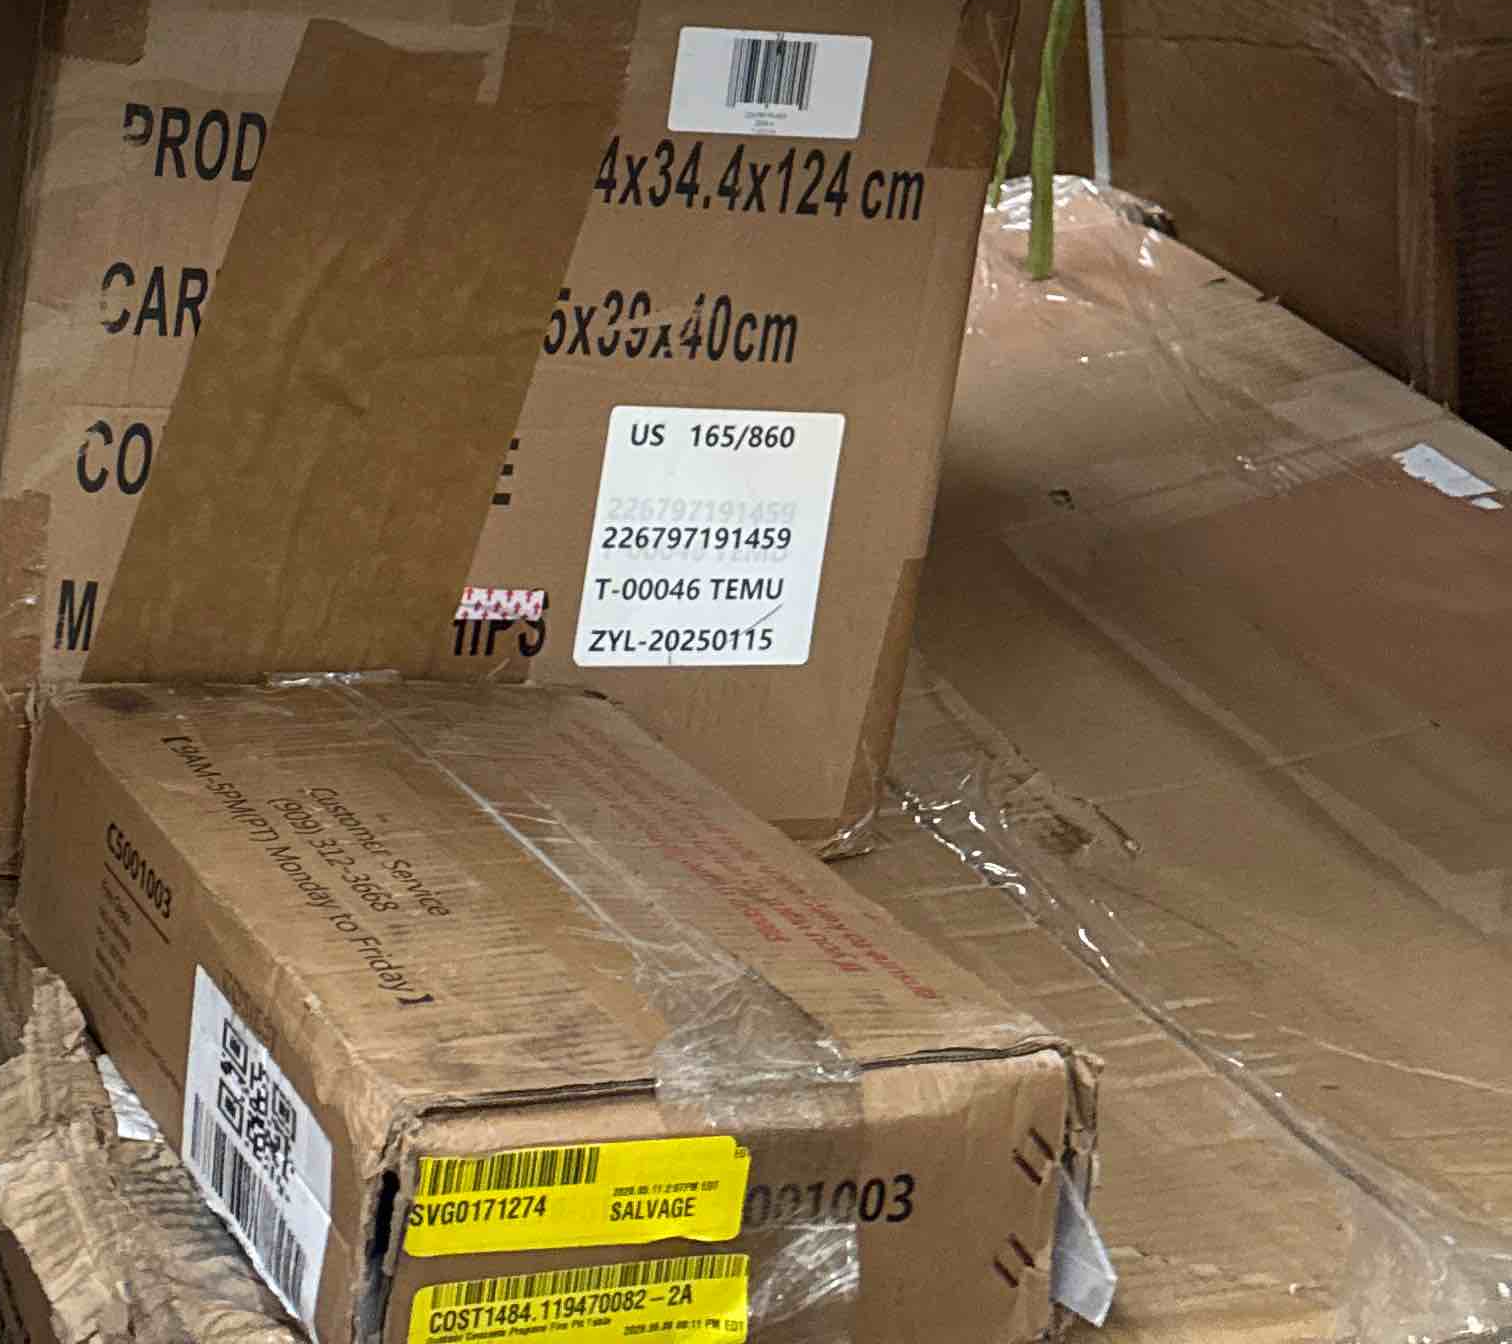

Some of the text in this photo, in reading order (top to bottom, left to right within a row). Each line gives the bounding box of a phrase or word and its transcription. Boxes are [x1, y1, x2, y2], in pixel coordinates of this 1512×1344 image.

[122, 102, 269, 183] PROD
[860, 168, 926, 222] cm
[100, 261, 209, 337] CAR
[76, 419, 155, 496] CO
[631, 423, 796, 451] US 165/860
[601, 526, 792, 549] 226797191459
[53, 578, 100, 652] M
[594, 577, 785, 601] T-00046 TEMU
[587, 627, 774, 652] ZYL-20250115
[267, 796, 399, 913] (909) 312-3668
[310, 787, 451, 917] Customer Service
[266, 846, 341, 910] Monday
[330, 912, 358, 933] to
[408, 1194, 697, 1227] SVG0171274 SALVAGE
